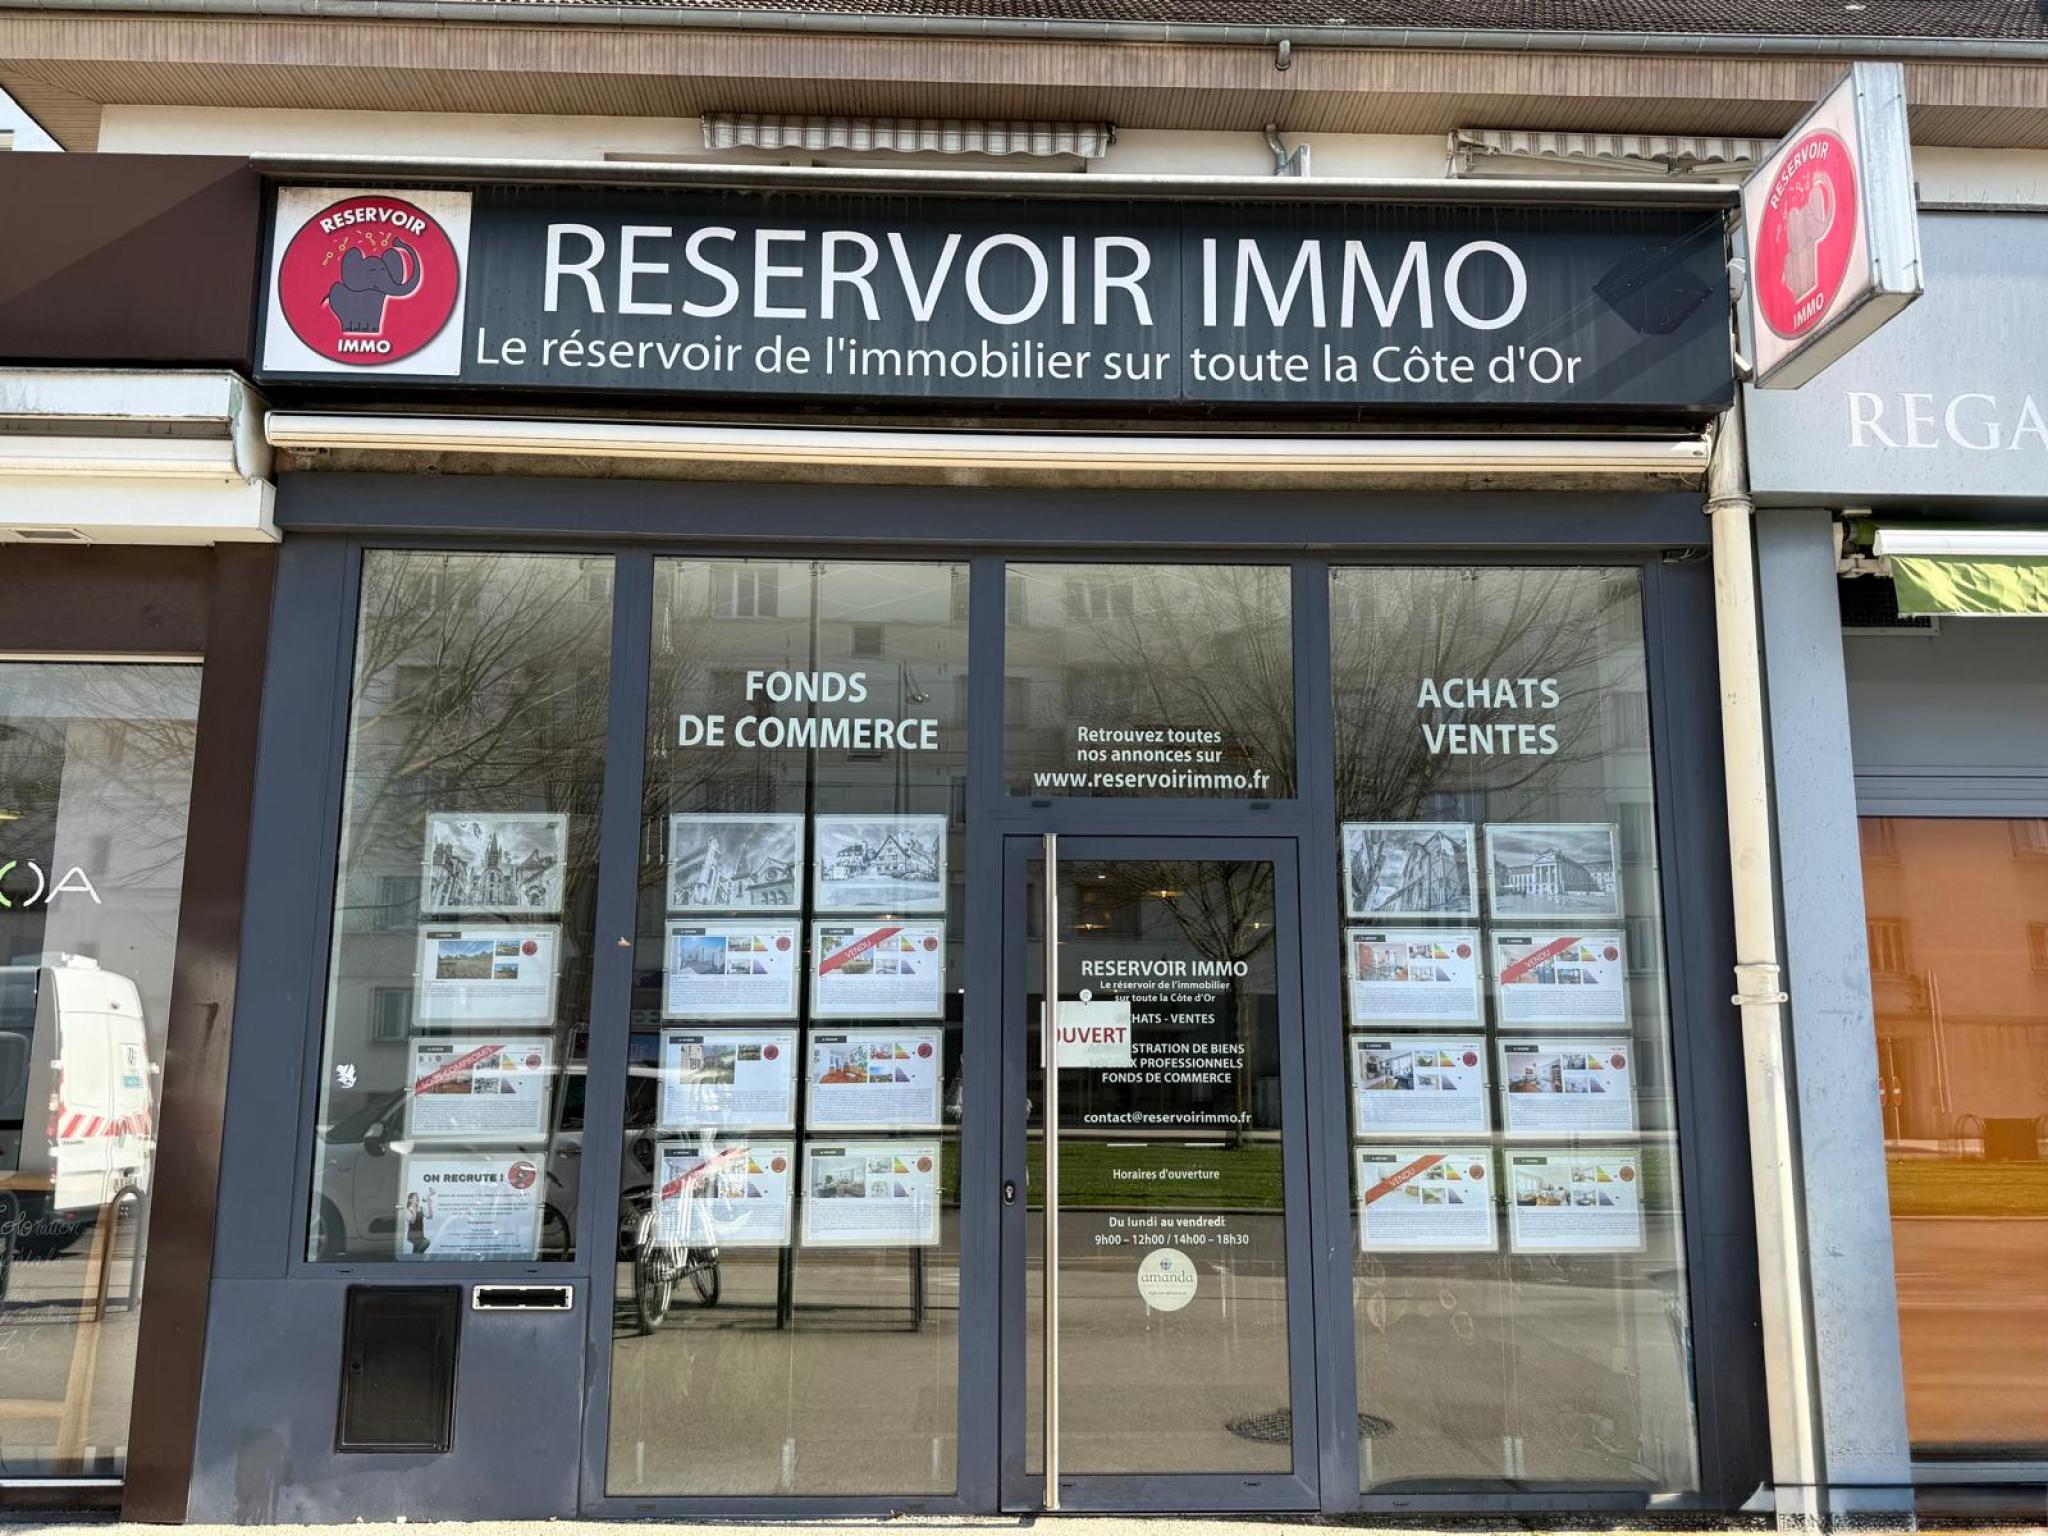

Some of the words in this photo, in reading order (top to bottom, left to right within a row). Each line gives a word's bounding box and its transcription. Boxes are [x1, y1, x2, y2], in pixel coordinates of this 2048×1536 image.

[1770, 140, 1829, 210] RESERVOIR
[321, 206, 426, 235] RESERVOIR
[544, 223, 1154, 326] RESERVOIR
[1203, 237, 1528, 330] IMMO
[1793, 292, 1825, 330] IMMO
[337, 339, 391, 355] IMMO
[476, 327, 526, 365] Le
[542, 332, 741, 373] réservoir
[755, 334, 810, 375] de
[826, 335, 1092, 381] l'immobilier
[1103, 351, 1170, 381] sur
[1191, 349, 1308, 384] toute
[1324, 346, 1357, 384] la
[1372, 345, 1474, 385] Côte
[1489, 346, 1582, 386] d'Or
[746, 670, 868, 704] FONDS
[1417, 677, 1560, 709] ACHATS
[679, 714, 725, 747] DE
[735, 715, 938, 750] COMMERCE
[1077, 726, 1163, 742] Retrouvez
[1167, 728, 1222, 743] toutes
[1422, 723, 1559, 755] VENTES
[1077, 748, 1107, 761] nos
[1111, 748, 1192, 762] annonces
[1196, 749, 1223, 762] sur
[1033, 768, 1271, 790] www.reservoirimmo.fr
[1525, 948, 1551, 970] VENDU
[1081, 960, 1187, 977] RESERVOIR
[1192, 961, 1249, 977] IMMO
[1100, 980, 1111, 989] Le
[1113, 980, 1156, 989] réservoir
[1157, 980, 1170, 989] de
[1172, 980, 1231, 990] l'immobilier
[1132, 994, 1158, 1003] toute
[1160, 993, 1169, 1003] la
[1170, 992, 1193, 1003] Côte
[1194, 993, 1216, 1003] d'Or
[1131, 1013, 1162, 1024] HATS
[1170, 1013, 1216, 1025] VENTES
[1192, 1043, 1208, 1054] DE
[1210, 1044, 1246, 1055] BIENS
[1140, 1057, 1244, 1070] PROFESSIONNELS
[1102, 1072, 1143, 1084] FONDS
[1145, 1072, 1162, 1084] DE
[1164, 1072, 1232, 1084] COMMERCE
[1083, 1111, 1252, 1125] contact@reservoirimmo.fr
[423, 1173, 440, 1184] ON
[443, 1173, 498, 1184] RECRUTE
[1113, 1168, 1157, 1180] Horaires
[1159, 1168, 1220, 1180] d'ouverture
[1109, 1216, 1125, 1227] Du
[1127, 1216, 1158, 1227] lundi
[1160, 1218, 1175, 1227] au
[1095, 1233, 1122, 1245] 9h00
[1132, 1233, 1165, 1245] 12h00
[1174, 1233, 1207, 1245] 14h00
[1217, 1233, 1249, 1245] 18h30
[1141, 1270, 1194, 1283] amanda
